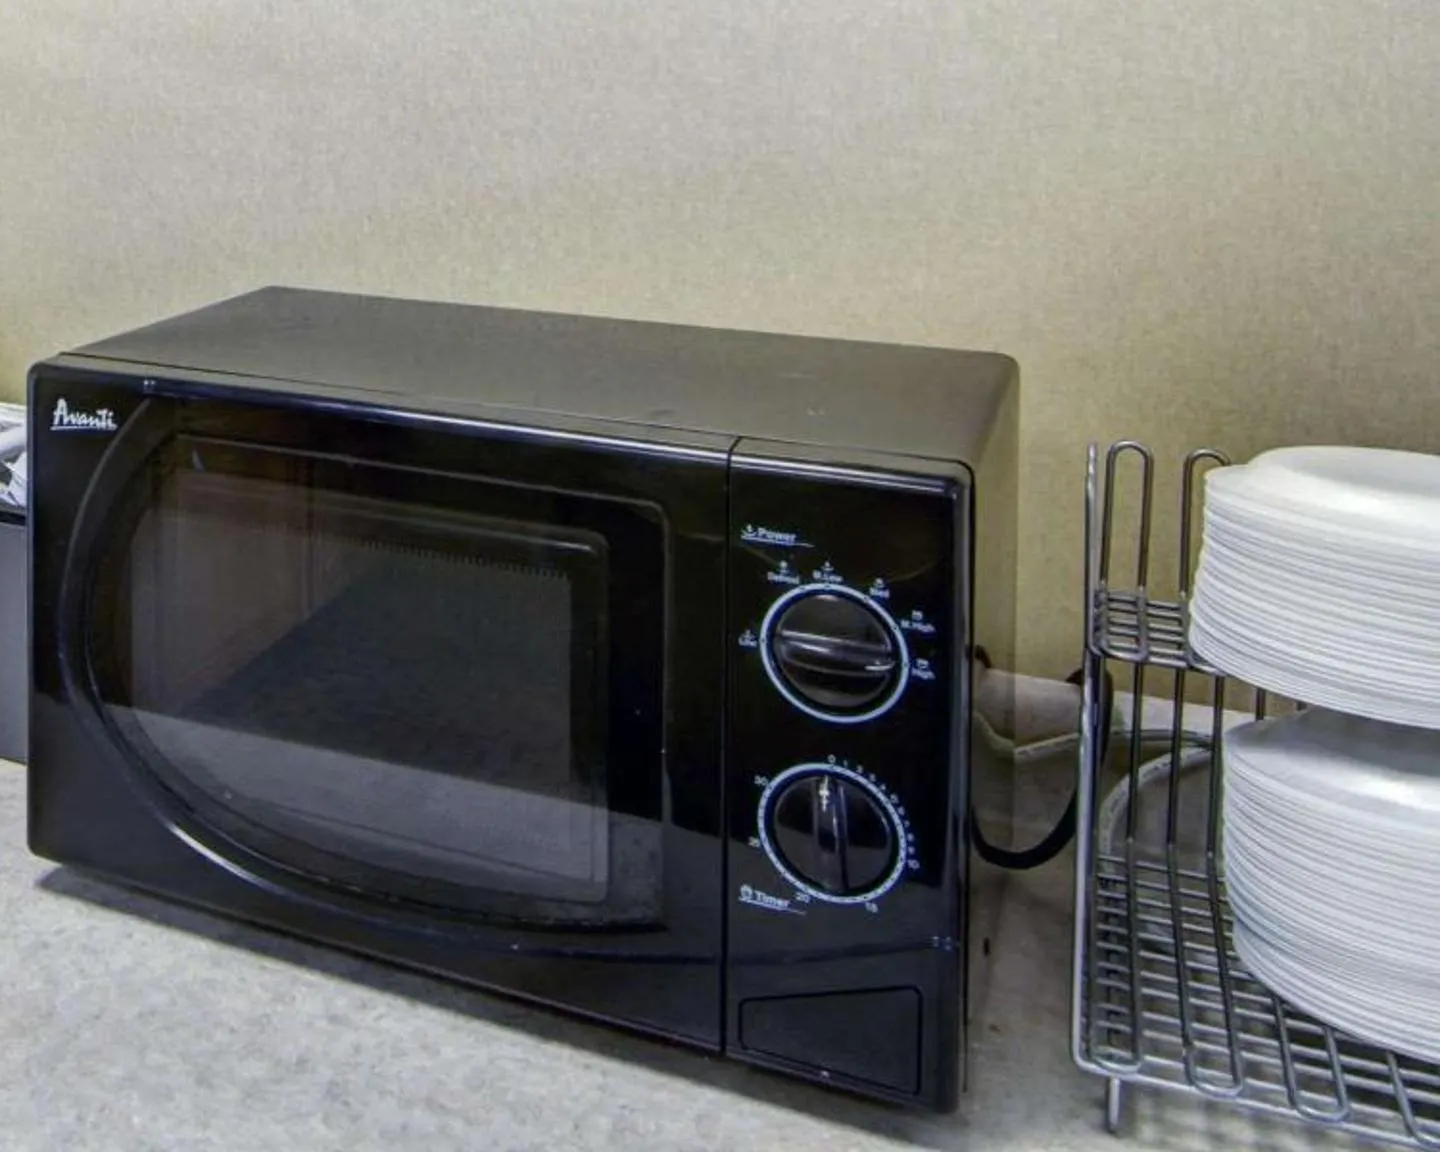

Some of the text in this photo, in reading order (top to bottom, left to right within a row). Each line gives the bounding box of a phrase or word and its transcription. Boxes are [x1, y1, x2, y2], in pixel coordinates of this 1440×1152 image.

[52, 397, 118, 431] Avanti
[758, 527, 797, 543] Power
[755, 890, 791, 908] Timer
